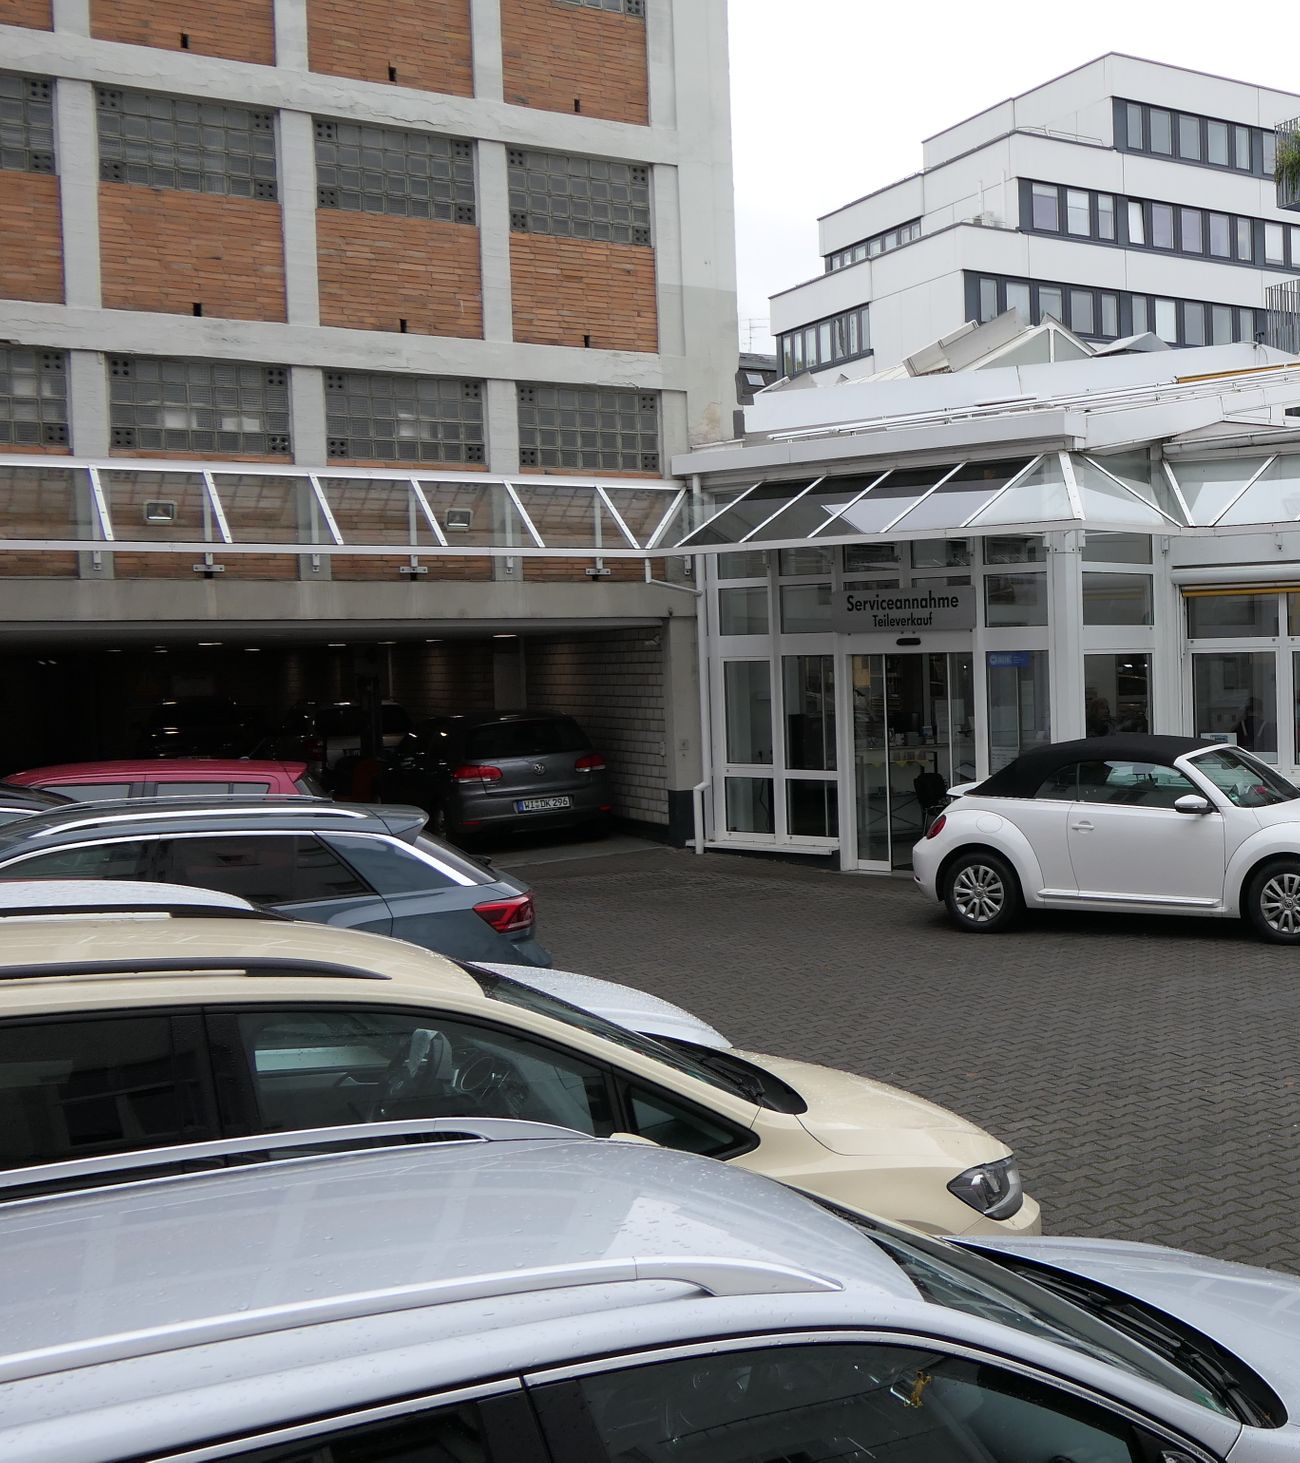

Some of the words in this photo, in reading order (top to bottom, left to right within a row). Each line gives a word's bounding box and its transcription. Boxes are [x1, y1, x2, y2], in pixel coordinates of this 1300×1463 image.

[846, 590, 959, 612] Serviceannahme
[872, 611, 933, 627] Teileverkauf
[552, 797, 568, 807] 296
